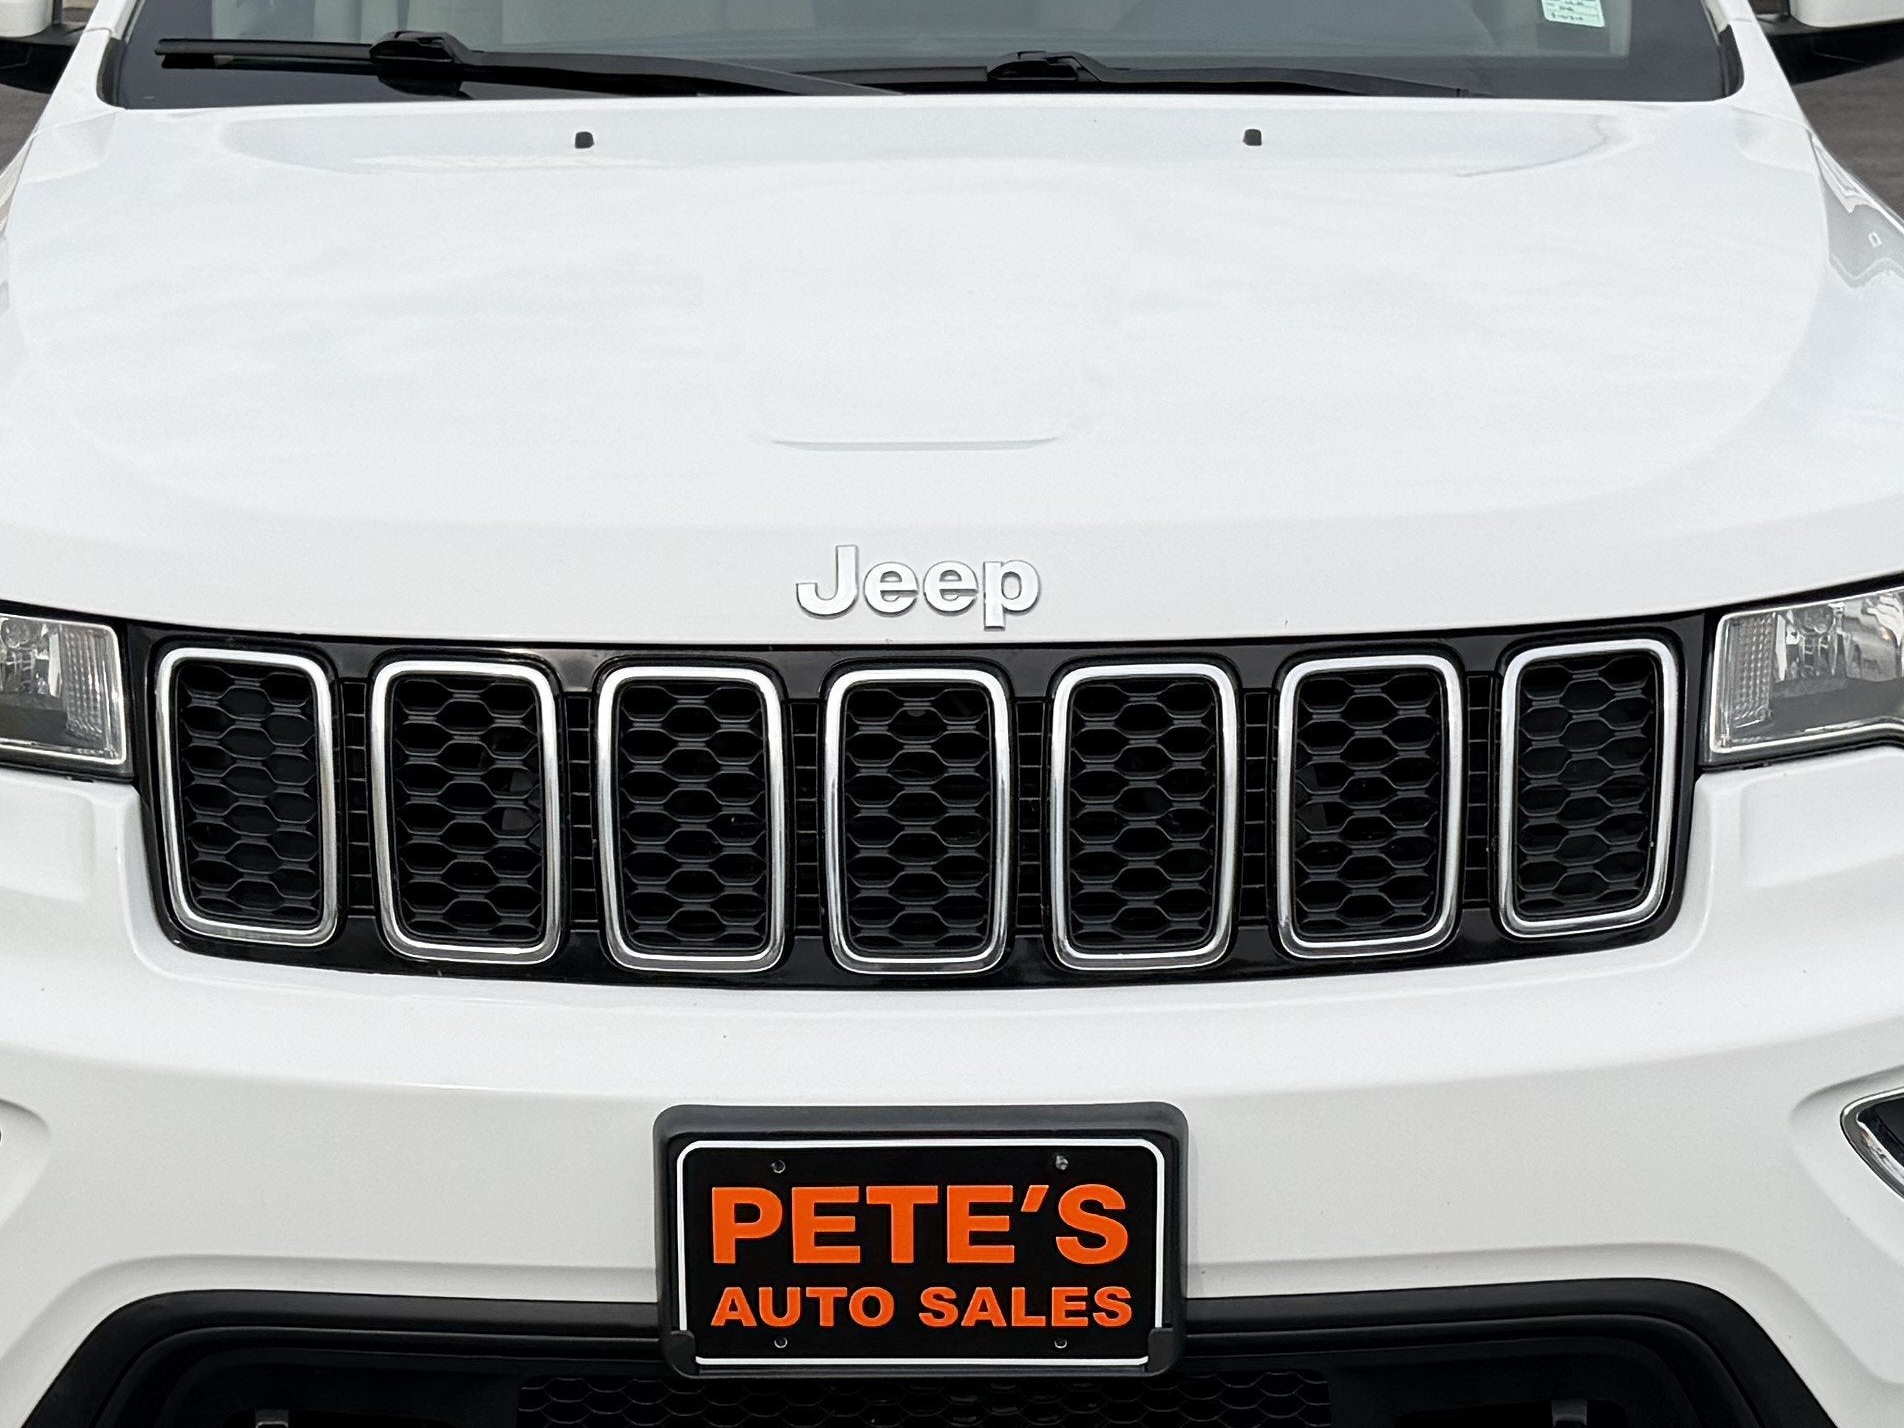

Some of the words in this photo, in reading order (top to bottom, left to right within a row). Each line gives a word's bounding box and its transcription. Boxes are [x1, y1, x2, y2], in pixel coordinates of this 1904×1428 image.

[795, 544, 1042, 632] Jeep
[710, 1183, 1129, 1265] PETE'S
[709, 1285, 895, 1328] AUTO
[917, 1285, 1133, 1328] SALES
